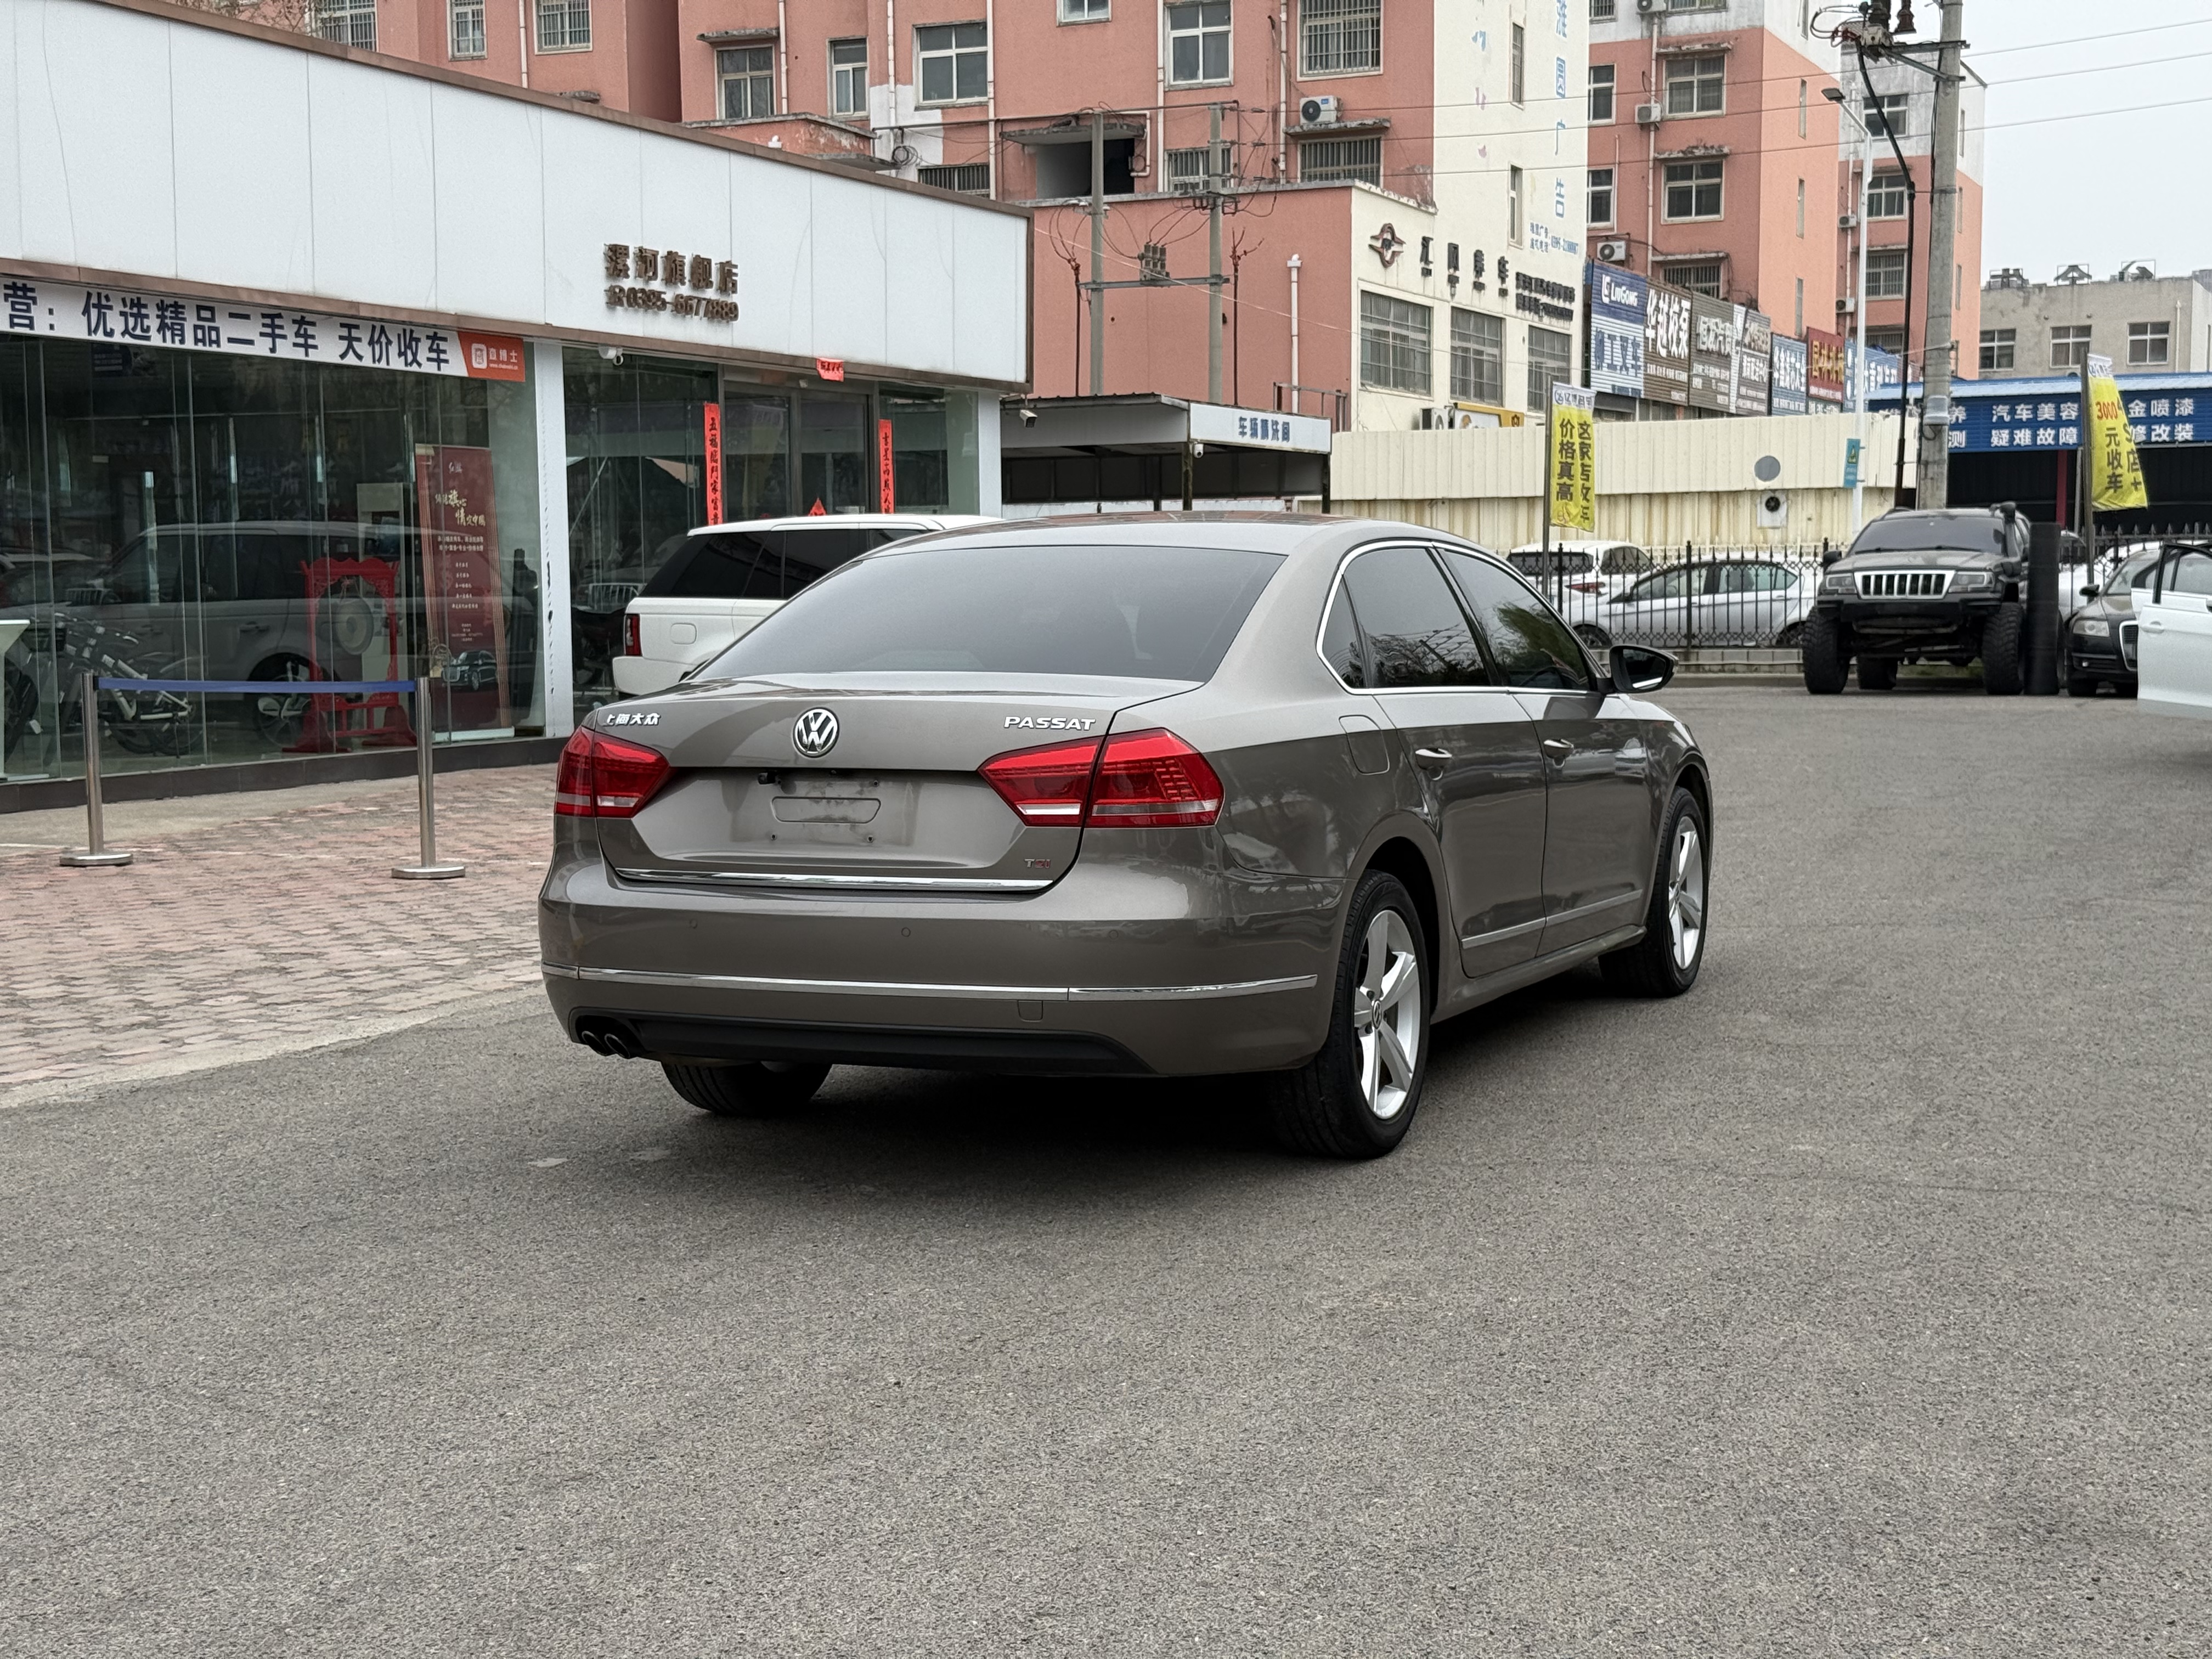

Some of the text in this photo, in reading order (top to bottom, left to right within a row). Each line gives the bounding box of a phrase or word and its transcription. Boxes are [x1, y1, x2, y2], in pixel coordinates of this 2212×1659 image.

[82, 290, 319, 358] 优选精品二手车
[338, 321, 450, 372] 天价收车
[1992, 402, 2079, 423] 汽车美容
[2128, 398, 2194, 418] 金喷漆
[1990, 426, 2078, 448] 疑难故障
[1556, 417, 1576, 502] 价格真高
[606, 713, 661, 726] 上海大众
[1004, 716, 1096, 731] PASSAT
